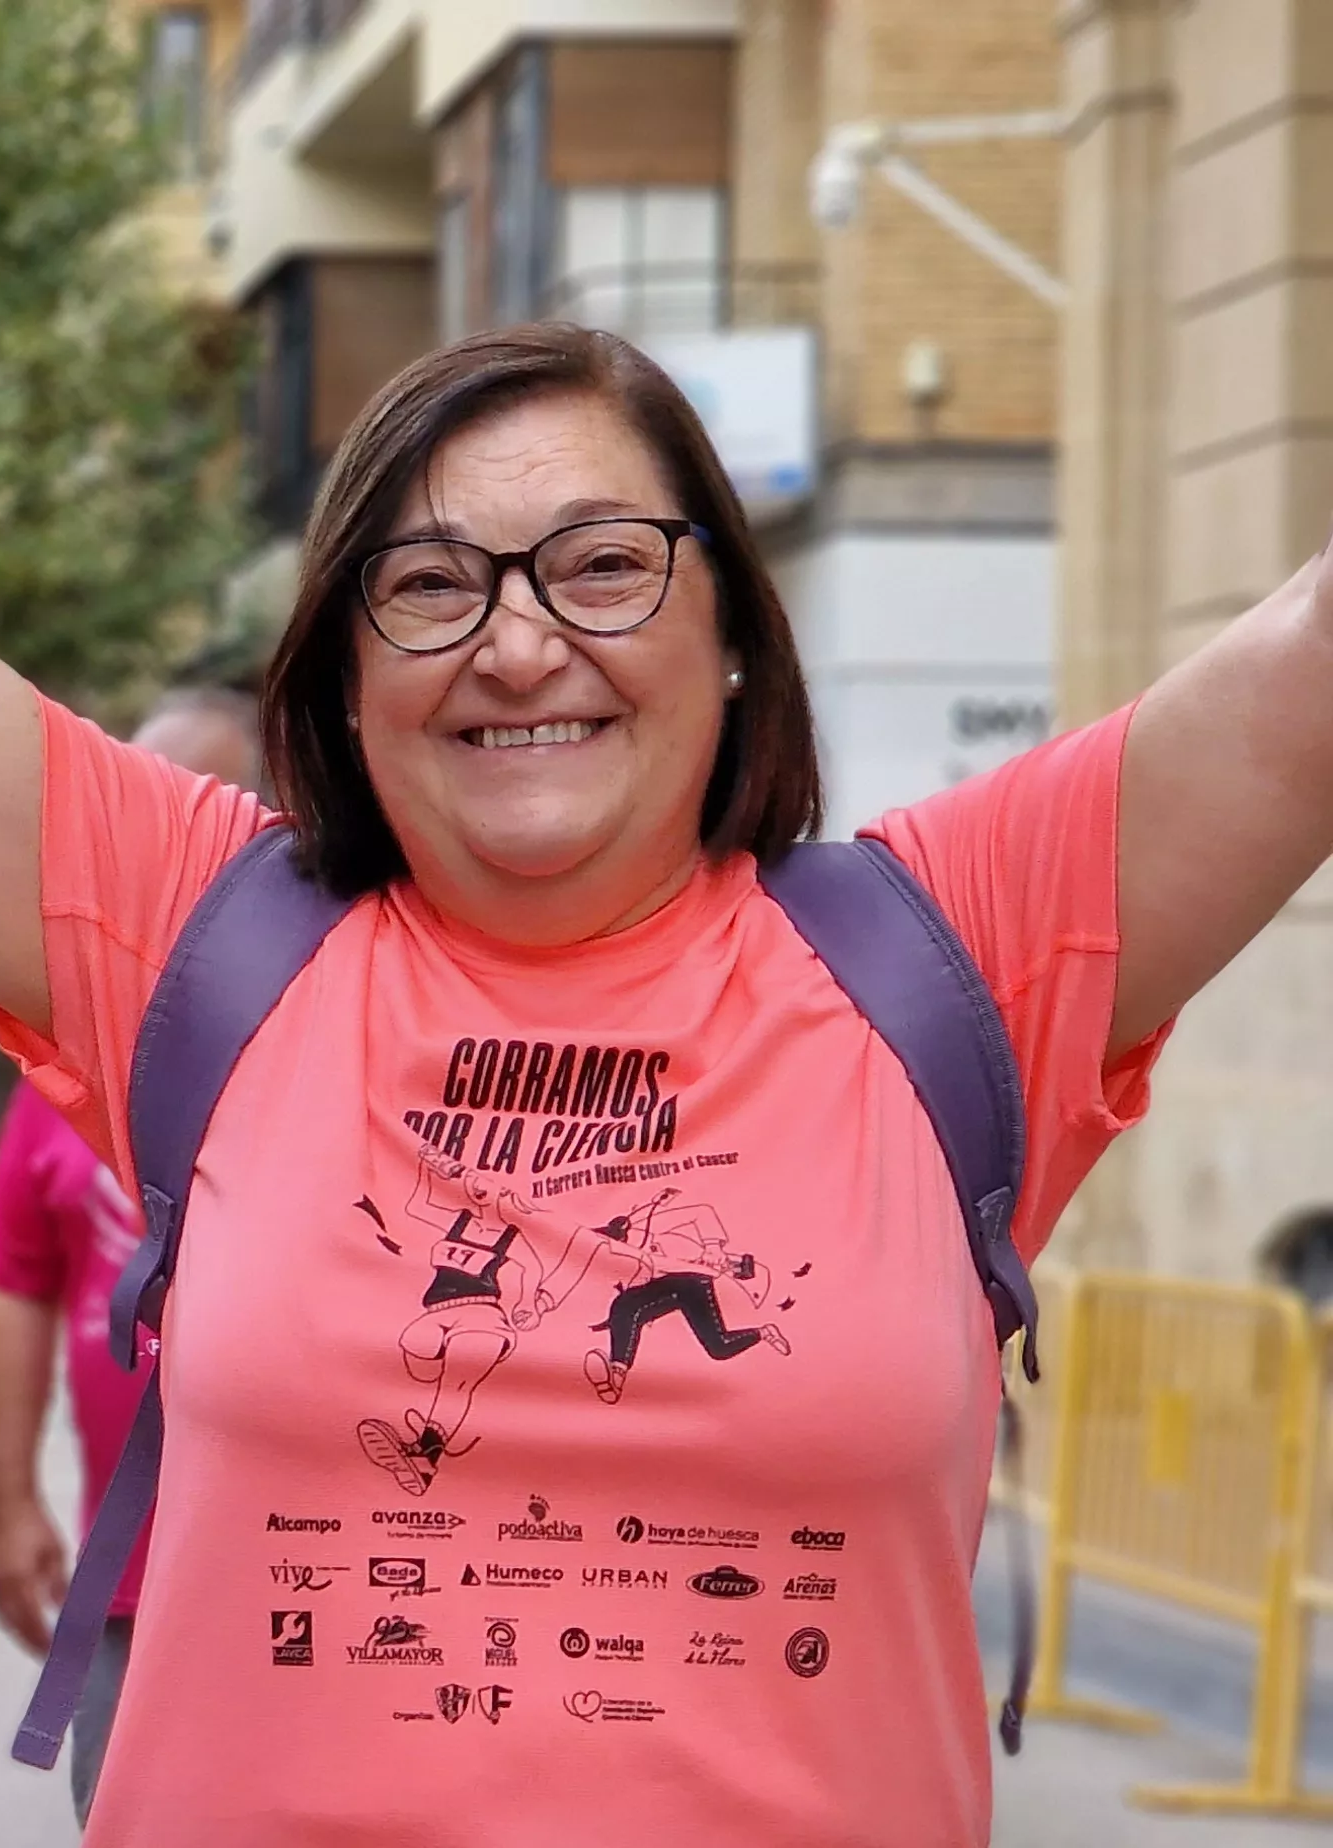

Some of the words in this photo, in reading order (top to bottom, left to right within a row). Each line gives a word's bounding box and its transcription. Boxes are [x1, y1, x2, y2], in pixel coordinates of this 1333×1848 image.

[443, 1037, 671, 1119] CORRAMOS
[476, 1115, 525, 1175] LA
[531, 1093, 679, 1175] CIENCIA
[532, 1181, 544, 1199] XI
[545, 1167, 593, 1197] Carrera
[595, 1163, 637, 1186] Huesca
[639, 1160, 680, 1181] contra
[683, 1156, 694, 1170] el
[444, 1244, 477, 1268] 19
[266, 1513, 342, 1535] Alcampo
[371, 1510, 446, 1525] avanza
[497, 1518, 583, 1542] podoactiva
[648, 1524, 685, 1540] hoya
[687, 1527, 705, 1539] de
[707, 1526, 760, 1542] huesca
[791, 1525, 846, 1546] eboca
[486, 1563, 564, 1581] Humeco
[582, 1567, 669, 1584] URBAN
[699, 1576, 756, 1594] Ferrer
[783, 1578, 838, 1594] Arenas
[346, 1646, 445, 1664] VILLAMAYOR
[595, 1634, 644, 1655] walqa
